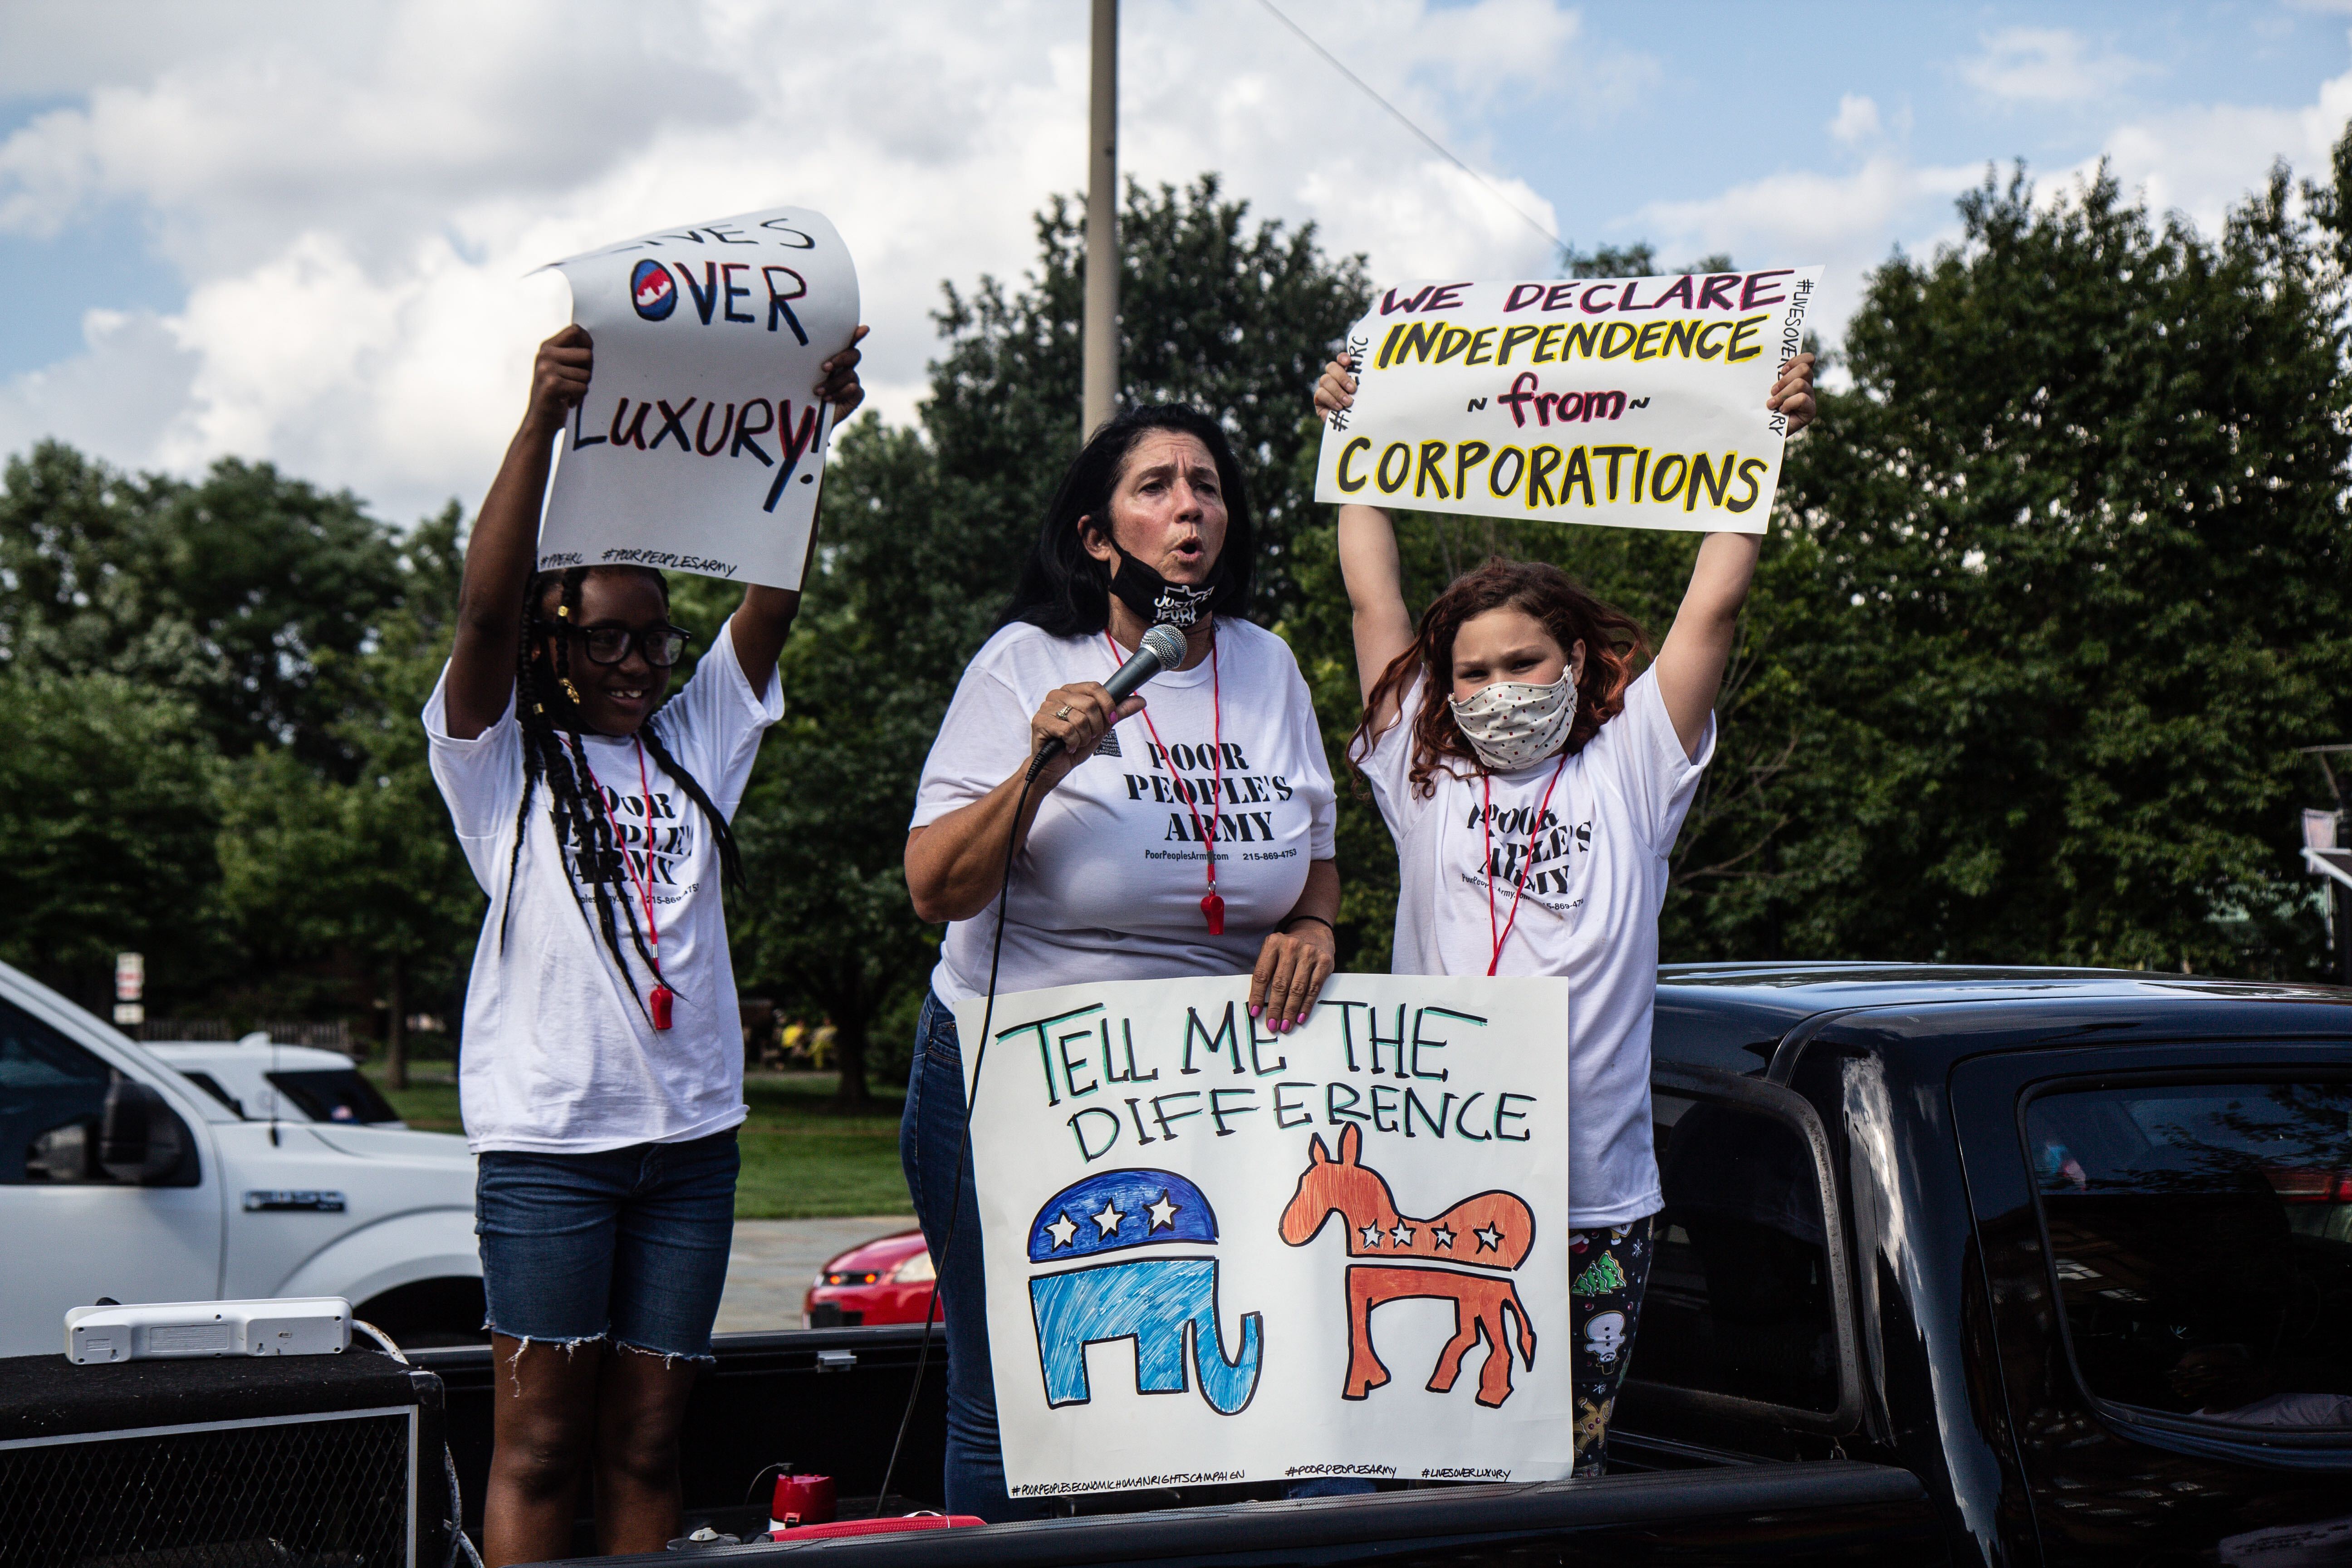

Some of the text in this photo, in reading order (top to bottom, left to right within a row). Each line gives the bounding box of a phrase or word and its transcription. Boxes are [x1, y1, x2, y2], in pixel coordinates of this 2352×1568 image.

[631, 259, 808, 346] OVER
[1380, 270, 1795, 315] WE DECLARE
[1374, 314, 1771, 369] INDEPENDENCE
[573, 397, 827, 513] LUXURY!
[1337, 436, 1768, 514] CORPORATIONS
[602, 548, 737, 577] #POORPEOPLESARMY
[1146, 741, 1249, 771] POOR
[1123, 774, 1293, 805] PEOPLE'S
[1164, 812, 1274, 842] ARMY
[1145, 848, 1297, 861] PoorPeoplesArmcom 215-869-4753
[995, 1000, 1488, 1107] TELL ME THE
[1067, 1082, 1537, 1163] DIFFERENCE
[1285, 1464, 1397, 1479] #POORPEOPLESARMY
[1421, 1467, 1511, 1482] #LIVESOVERLUXURY
